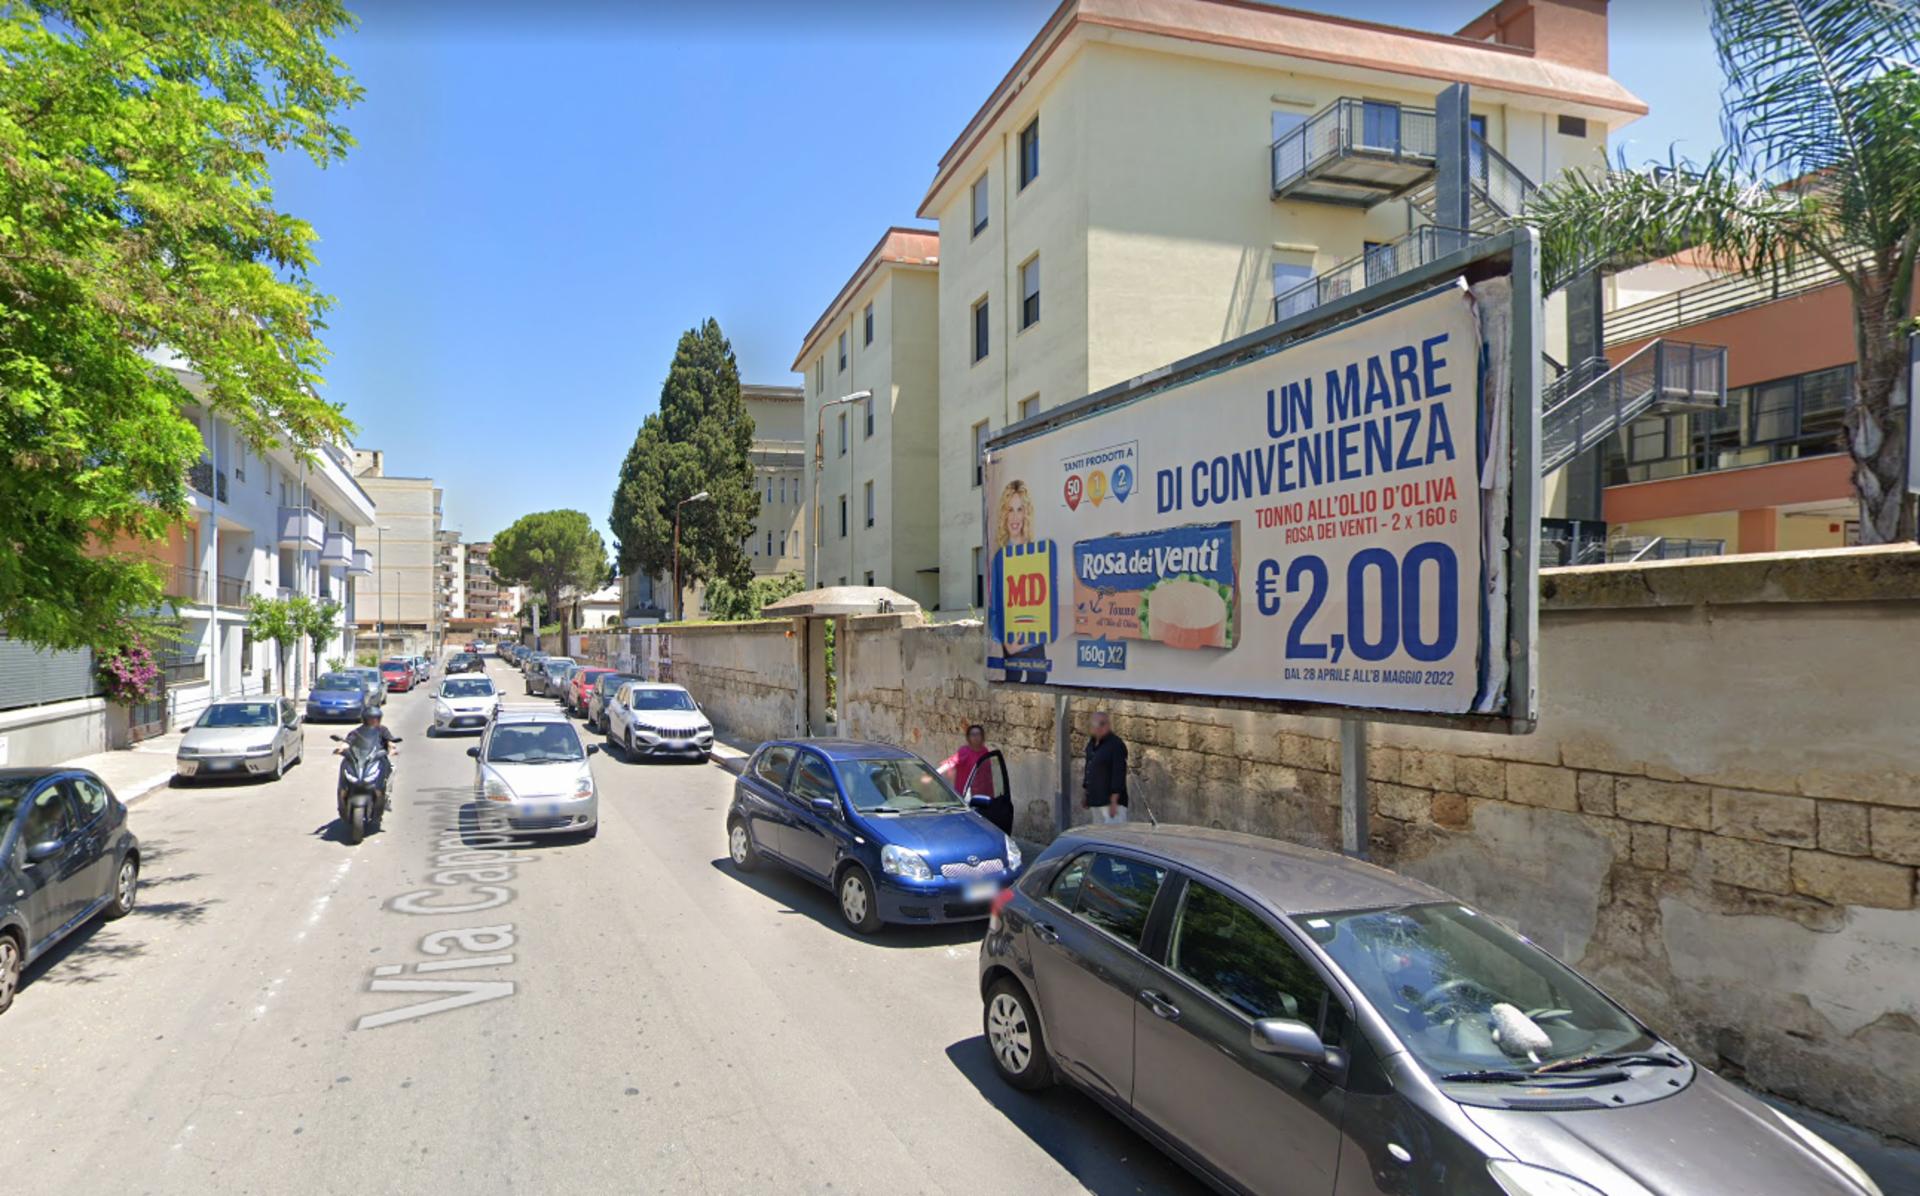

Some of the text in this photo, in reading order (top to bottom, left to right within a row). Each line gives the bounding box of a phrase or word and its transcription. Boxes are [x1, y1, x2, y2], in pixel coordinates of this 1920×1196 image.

[1266, 333, 1452, 439] UN MARE
[1063, 447, 1133, 472] TANTI PRODOTTI A
[1156, 401, 1456, 514] DI CONVENIENZA
[1067, 479, 1080, 497] 50
[1117, 468, 1127, 488] 2
[1255, 476, 1457, 530] TONNO ALL'OLIO D'OLIVA
[1285, 526, 1314, 544] ROSA
[1317, 523, 1336, 540] DEI
[1340, 516, 1377, 537] VENTI
[1391, 512, 1401, 531] 2
[1416, 506, 1445, 528] 160
[1129, 549, 1153, 574] dei
[1154, 538, 1219, 578] Venti
[1006, 572, 1048, 608] MD
[1080, 644, 1123, 666] 160g X2
[1285, 667, 1301, 681] DAL
[1303, 668, 1316, 681] 28
[1317, 668, 1350, 682] APRILE
[1382, 670, 1423, 685] MAGGIO
[1424, 671, 1455, 686] 2022
